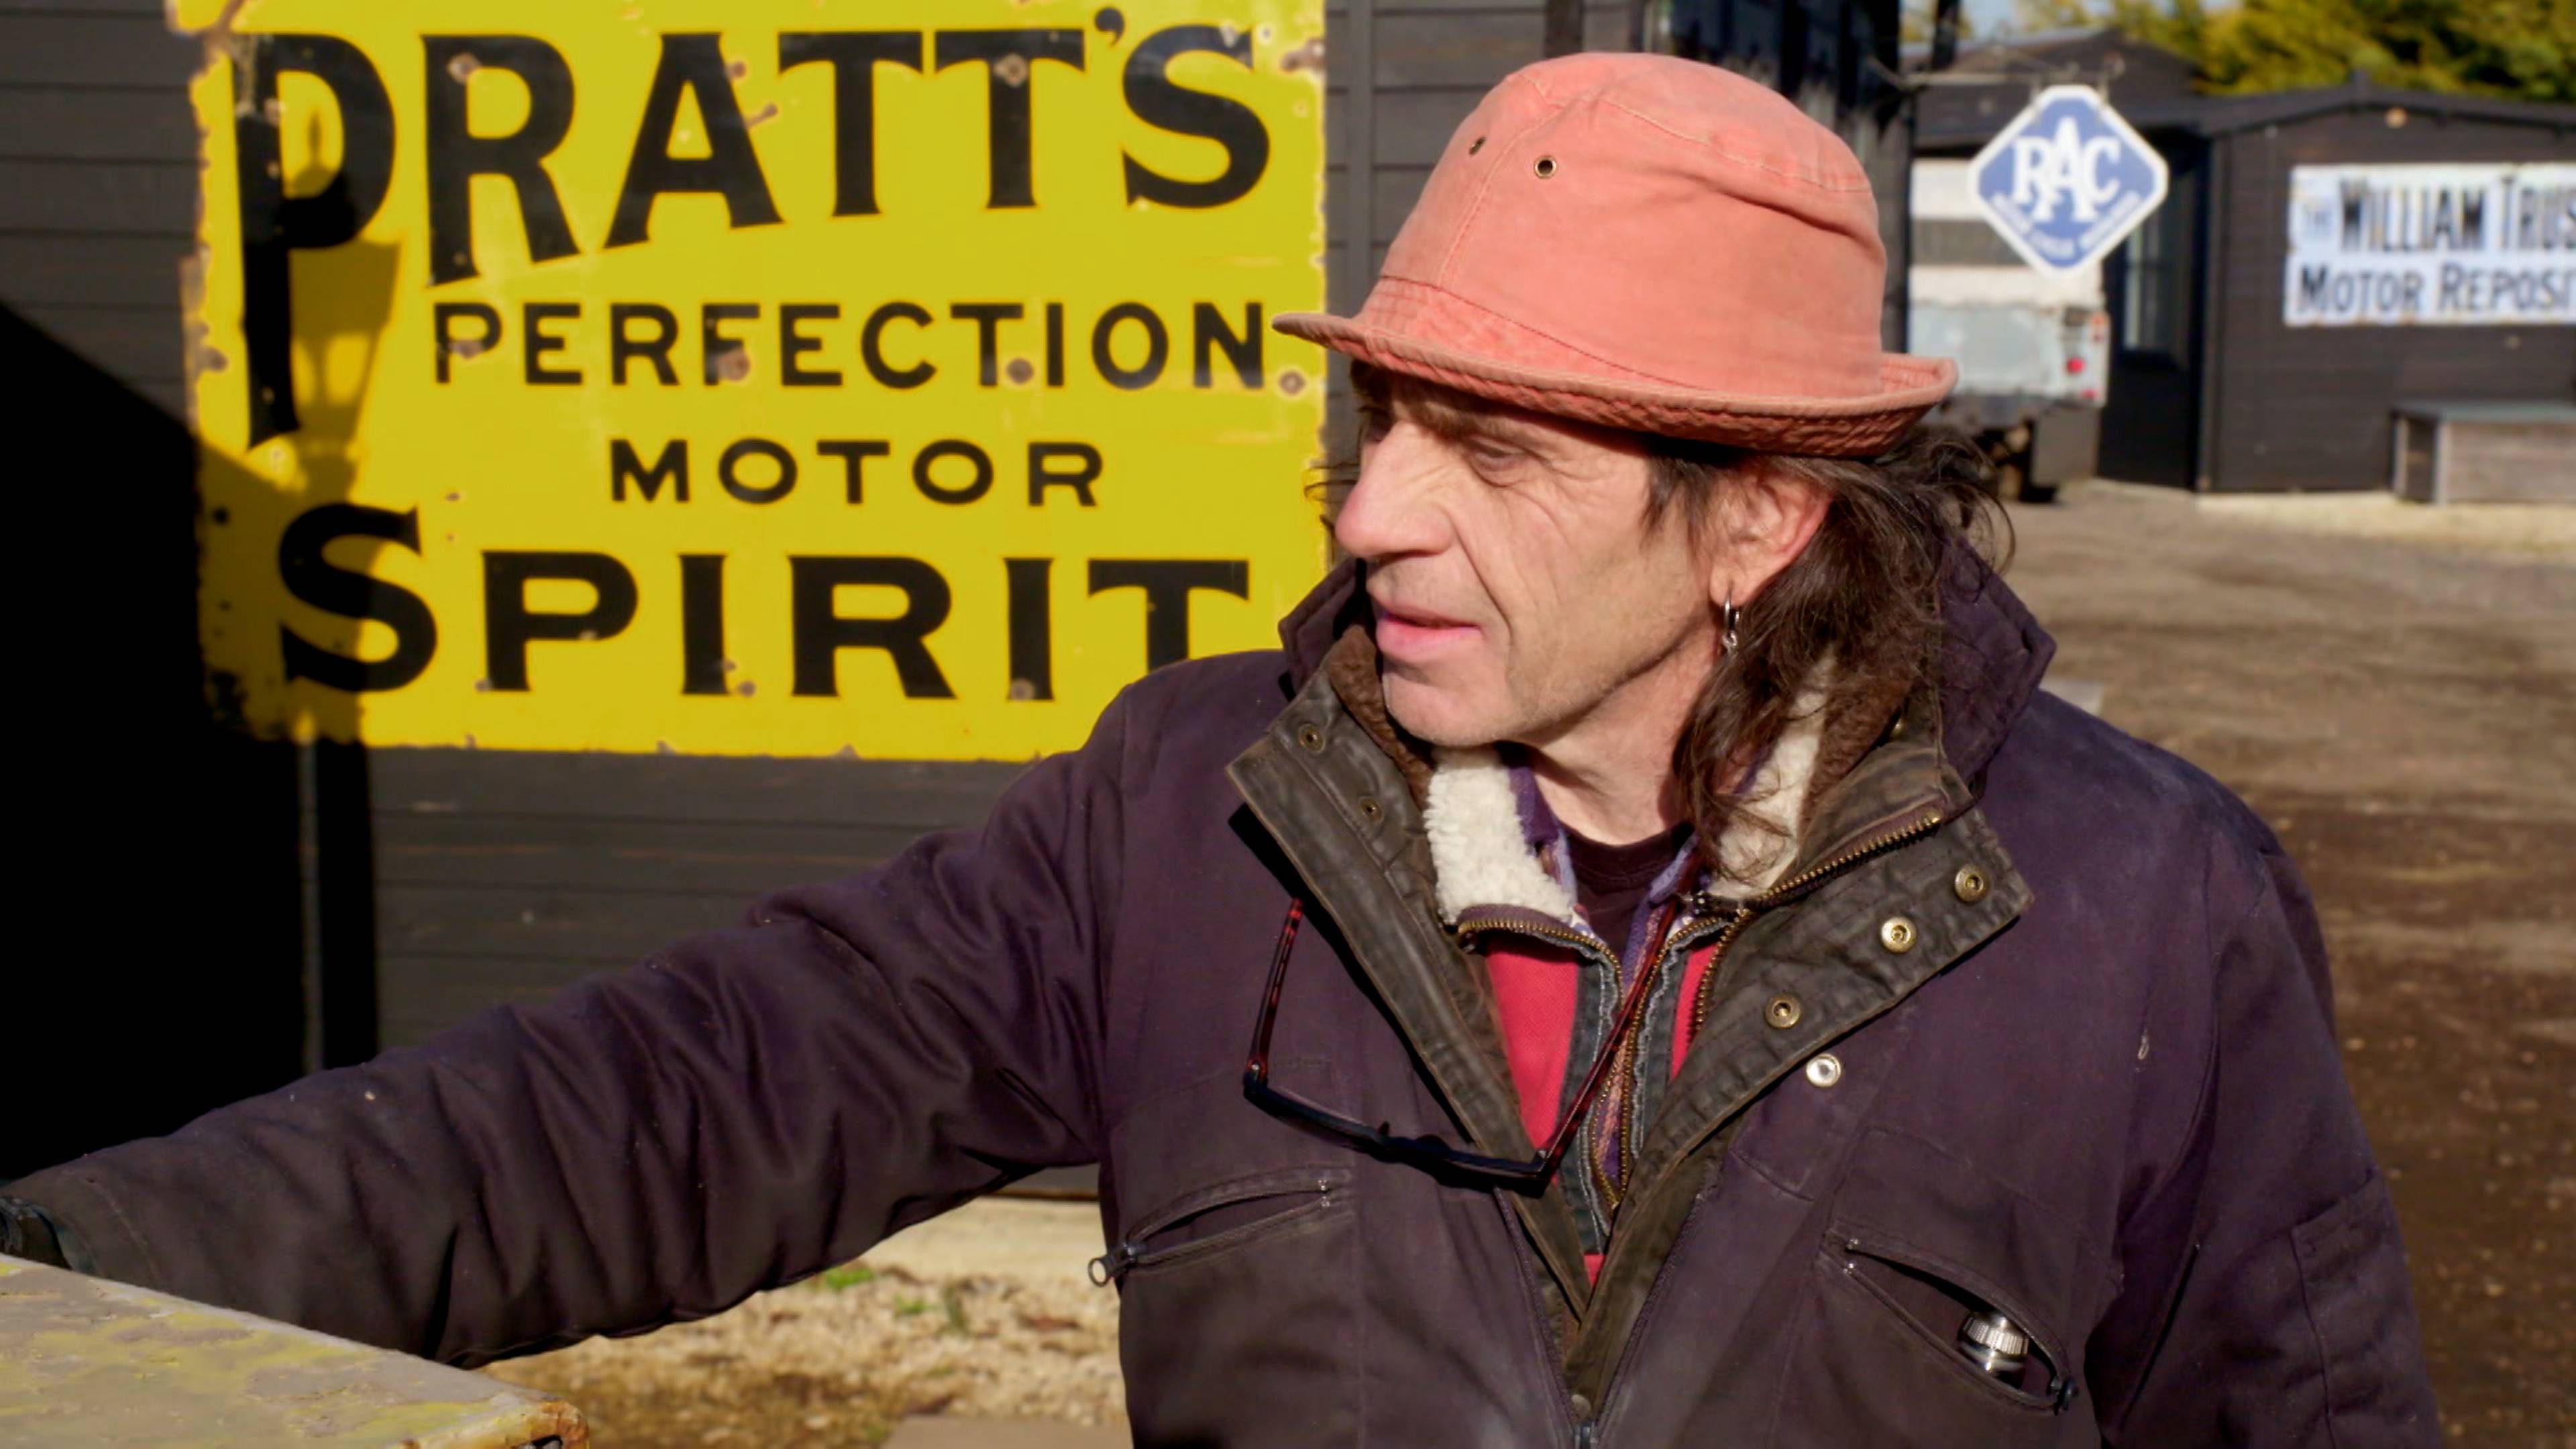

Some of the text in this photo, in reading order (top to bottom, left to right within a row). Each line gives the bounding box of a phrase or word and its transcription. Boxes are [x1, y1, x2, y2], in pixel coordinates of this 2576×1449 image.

[2014, 117, 2122, 222] RAC
[2339, 176, 2486, 252] WILLIAM
[231, 7, 1271, 451] PRATT'S
[2299, 262, 2424, 313] MOTOR
[433, 301, 1264, 390] PERFECTION
[610, 438, 1104, 508] MOTOR
[277, 502, 1250, 702] SPIRIT
